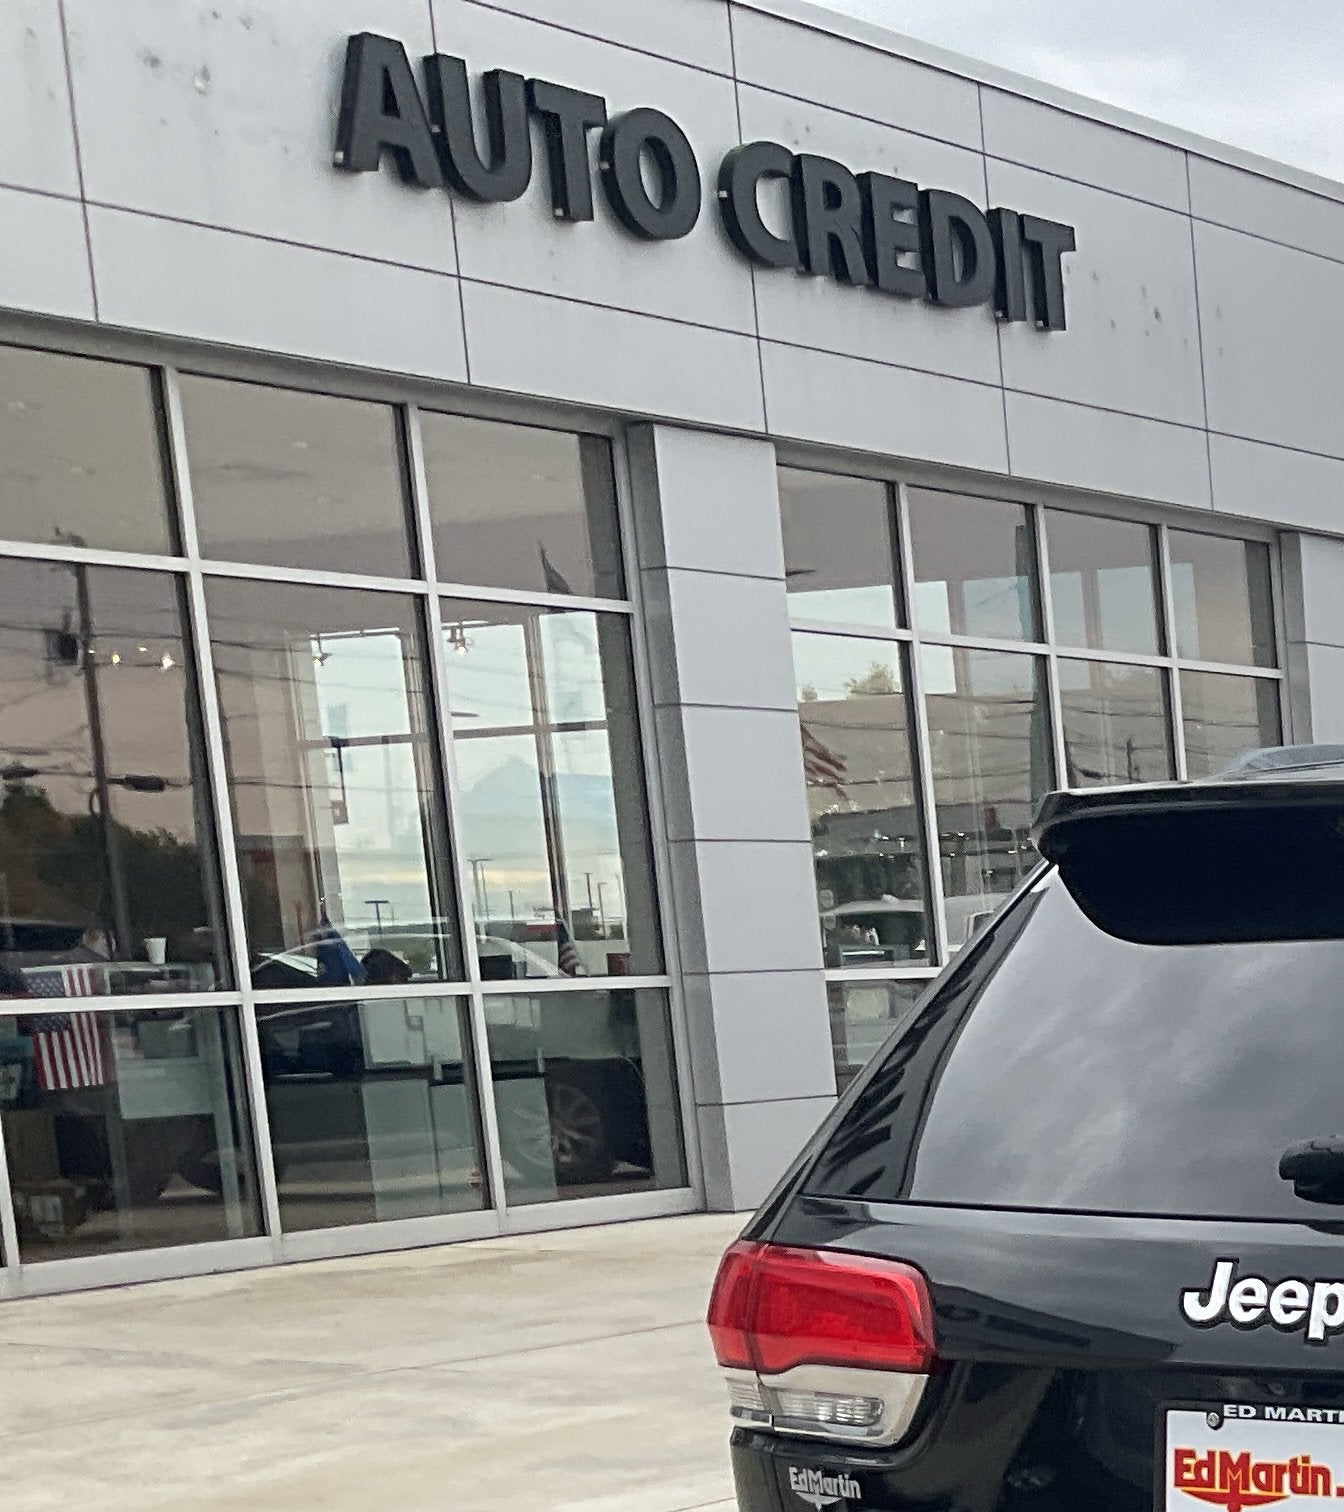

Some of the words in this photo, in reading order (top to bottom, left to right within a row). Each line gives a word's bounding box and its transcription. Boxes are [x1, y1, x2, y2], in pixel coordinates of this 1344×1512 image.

[334, 32, 701, 240] AUTO
[718, 141, 1076, 330] CREDIT
[1222, 1404, 1257, 1419] ED
[788, 1466, 862, 1500] EdMartin
